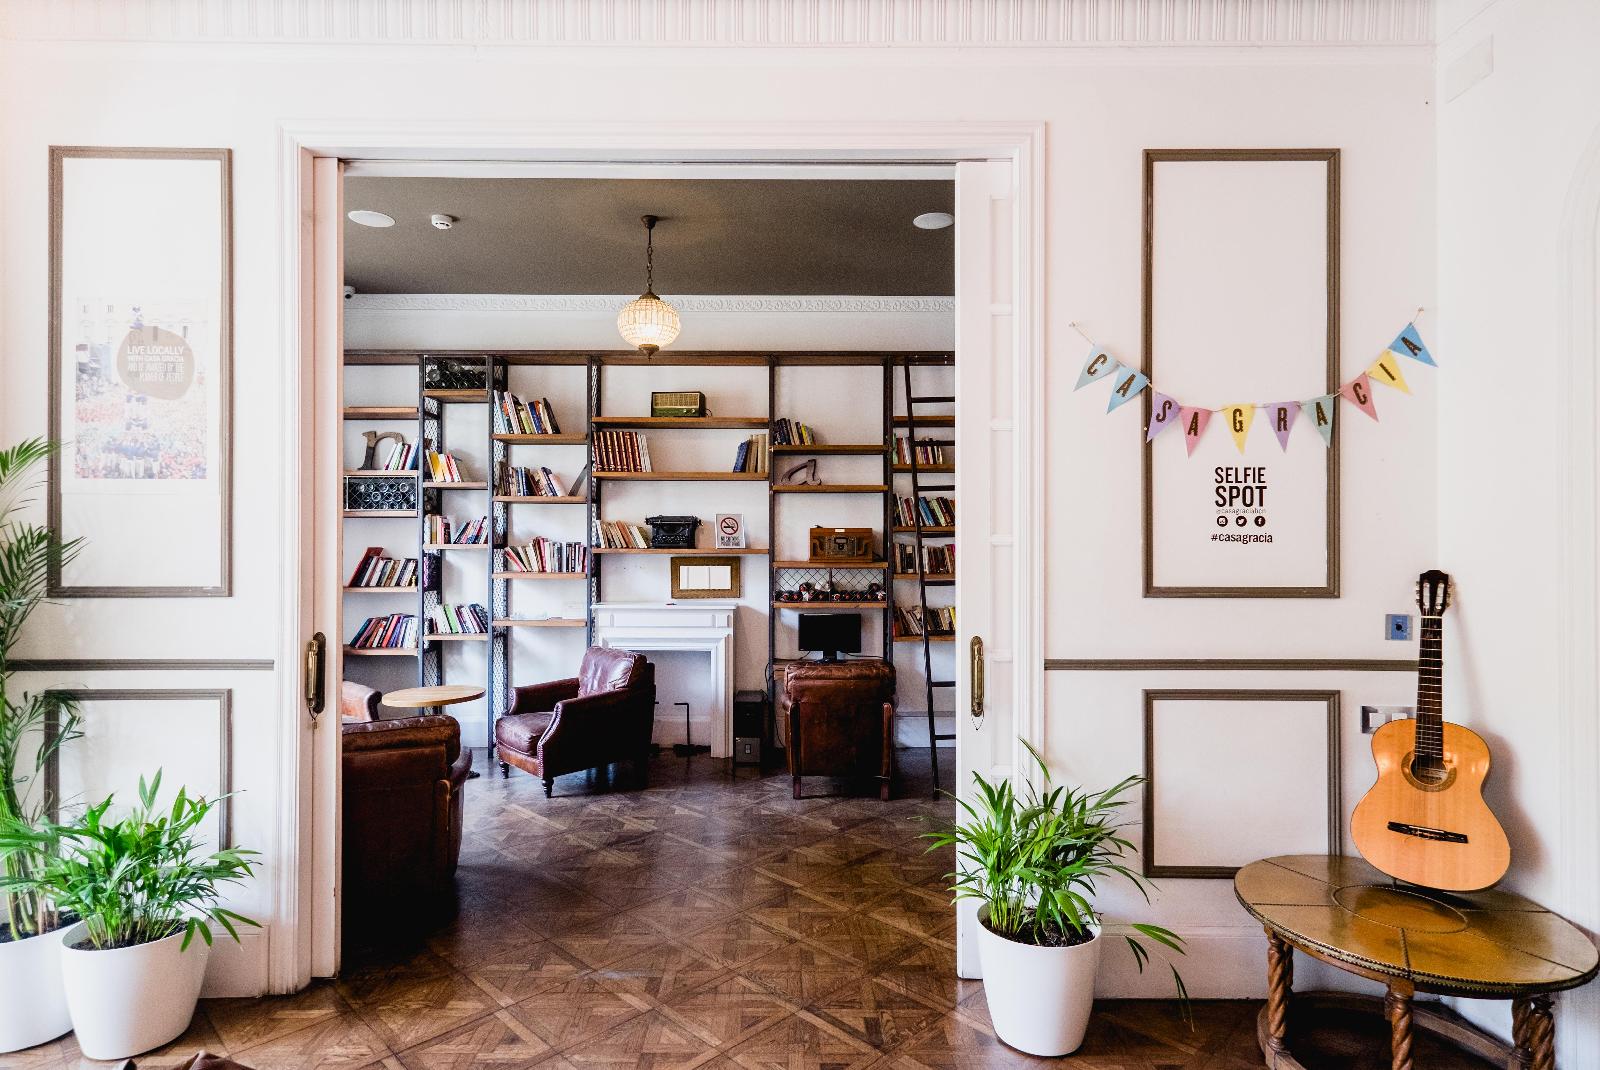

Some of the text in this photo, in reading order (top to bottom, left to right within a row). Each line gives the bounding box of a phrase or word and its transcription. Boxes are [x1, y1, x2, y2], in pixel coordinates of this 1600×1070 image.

[127, 345, 185, 355] LIVE LOCALLY
[1214, 466, 1266, 484] SELFIE
[1214, 485, 1268, 508] SPOT
[1210, 532, 1273, 545] #casagracia
